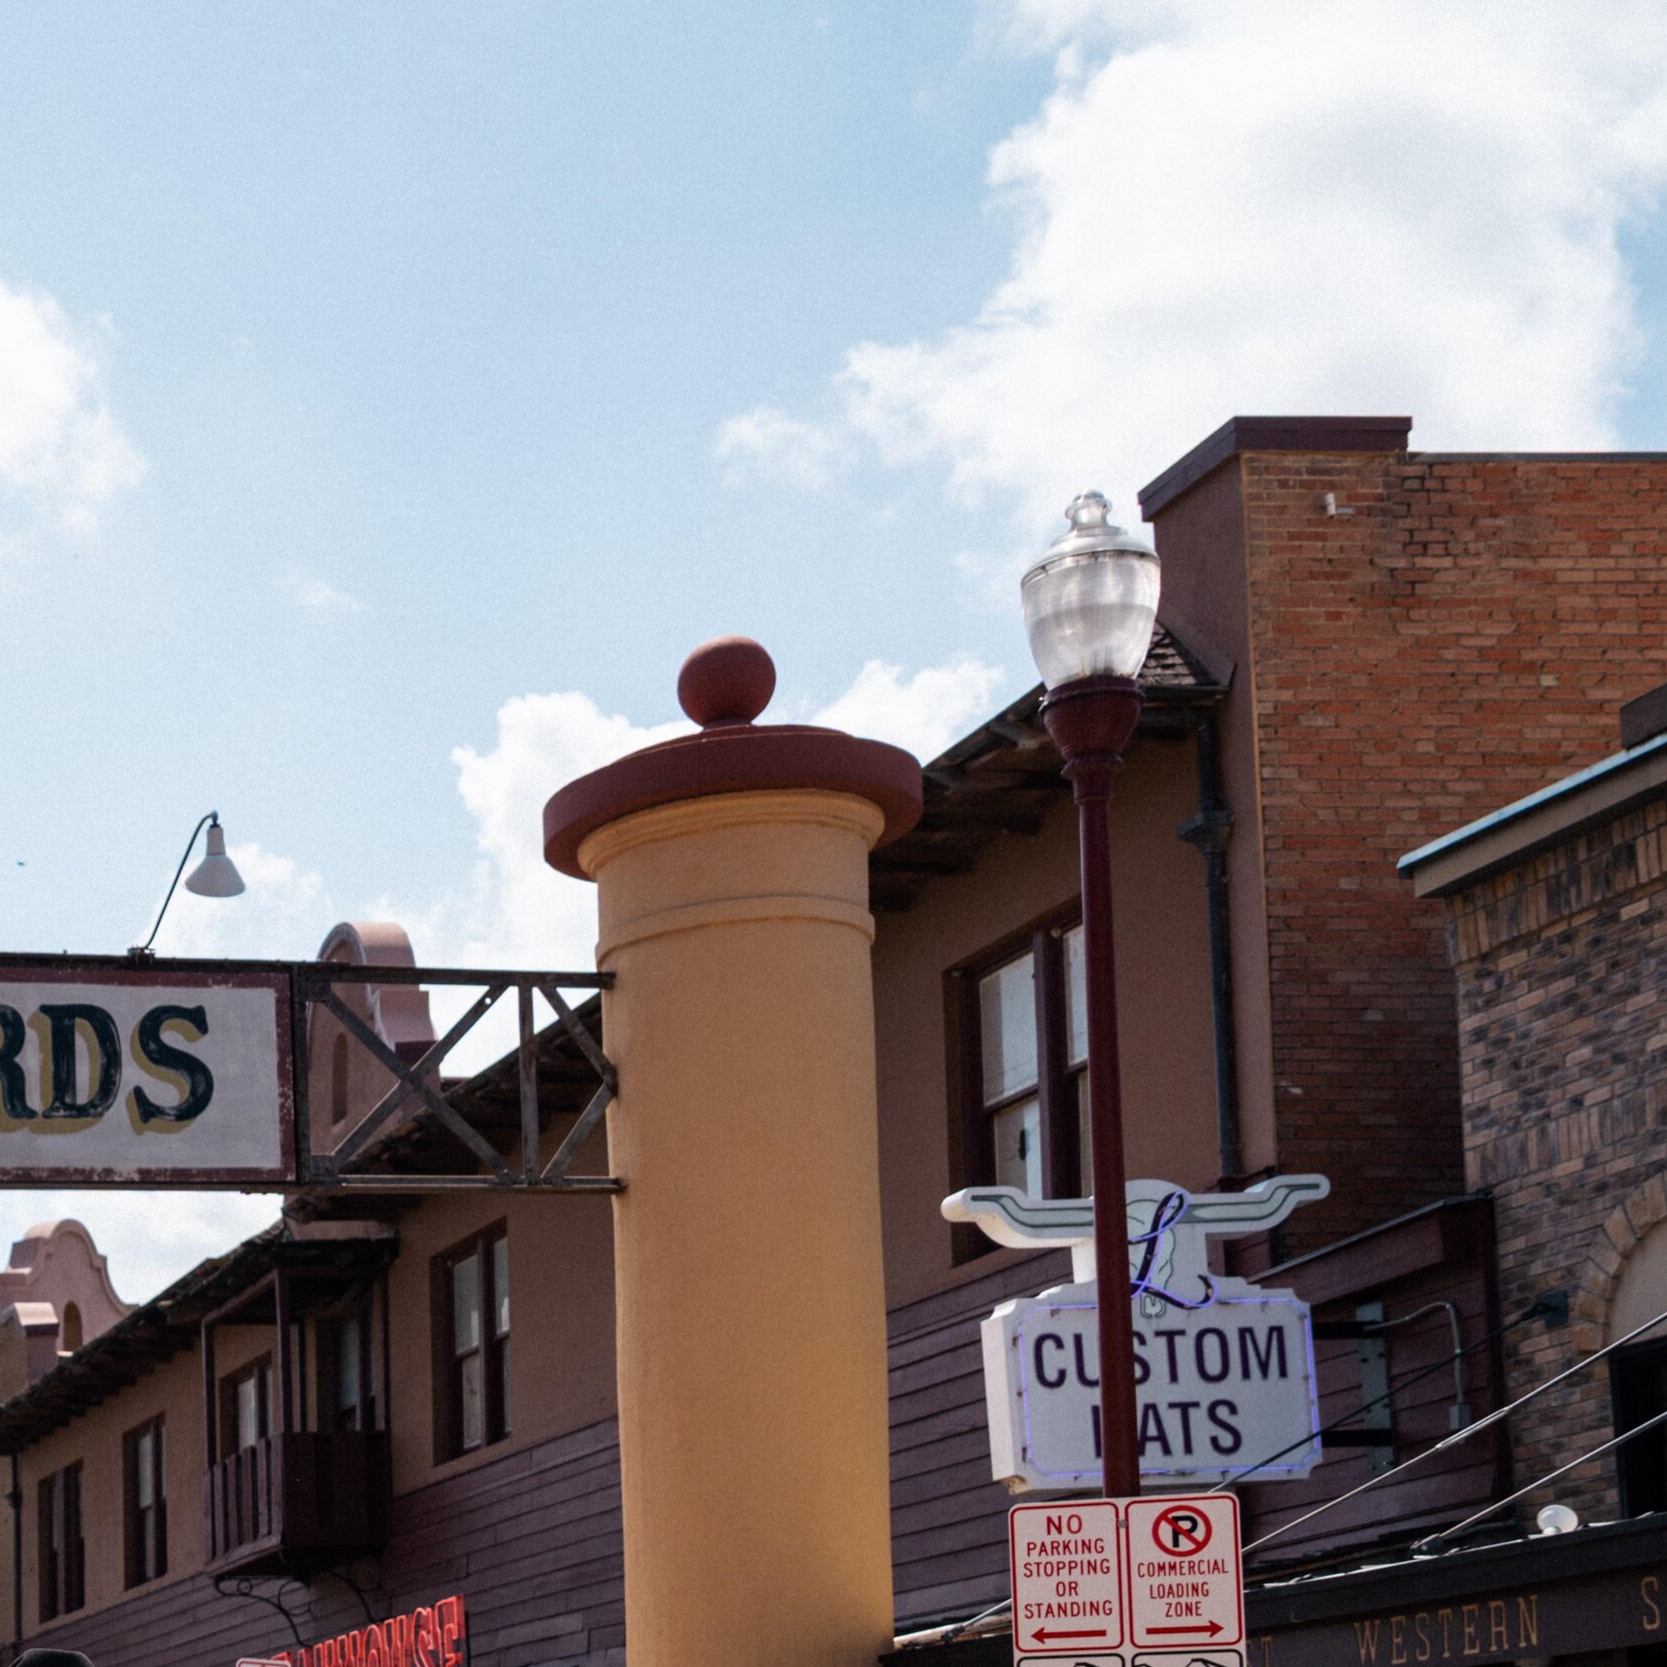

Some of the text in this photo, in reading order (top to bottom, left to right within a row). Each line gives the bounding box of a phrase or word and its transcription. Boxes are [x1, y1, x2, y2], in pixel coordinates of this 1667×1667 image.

[1033, 1325, 1289, 1389] CUSTOM
[1046, 1514, 1082, 1535] NO
[1027, 1538, 1105, 1557] PARKING
[1024, 1559, 1110, 1578] STOPPING
[1137, 1559, 1229, 1578] COMMERCIAL
[1056, 1582, 1078, 1597] OR
[1149, 1582, 1209, 1599] LOADING
[1024, 1600, 1113, 1619] STANDING
[1165, 1601, 1202, 1618] ZONE
[1353, 1594, 1540, 1666] WESTERN
